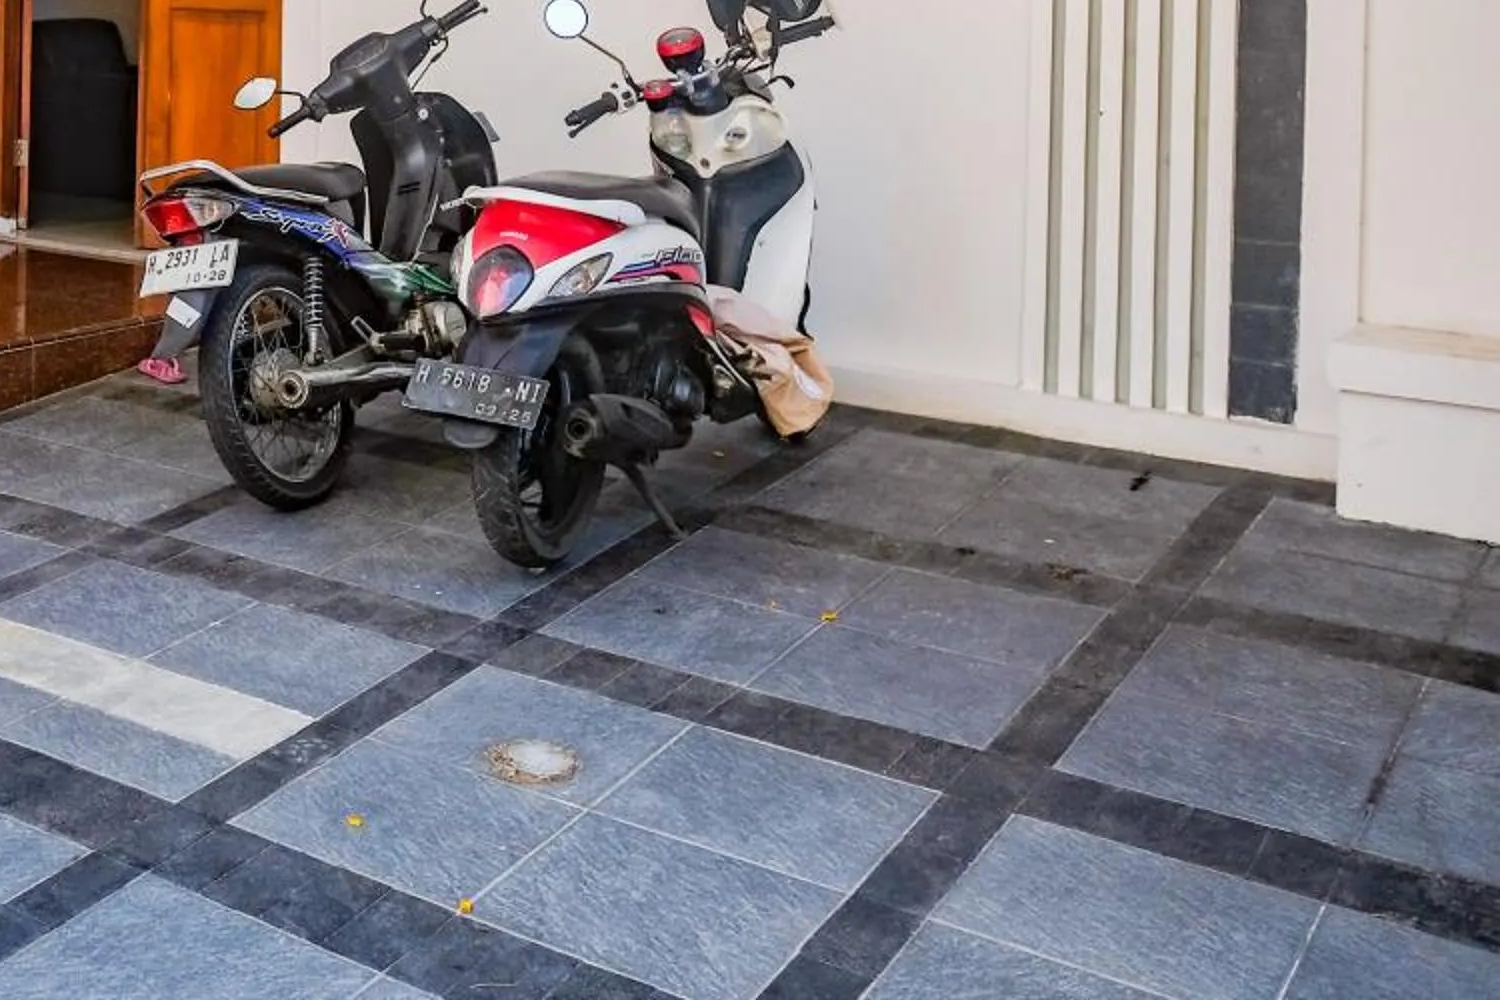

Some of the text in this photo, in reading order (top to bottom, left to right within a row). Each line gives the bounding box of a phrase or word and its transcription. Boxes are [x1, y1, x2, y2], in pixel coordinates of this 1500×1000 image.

[165, 247, 199, 269] 2931
[416, 363, 431, 383] H
[441, 367, 492, 393] 5618
